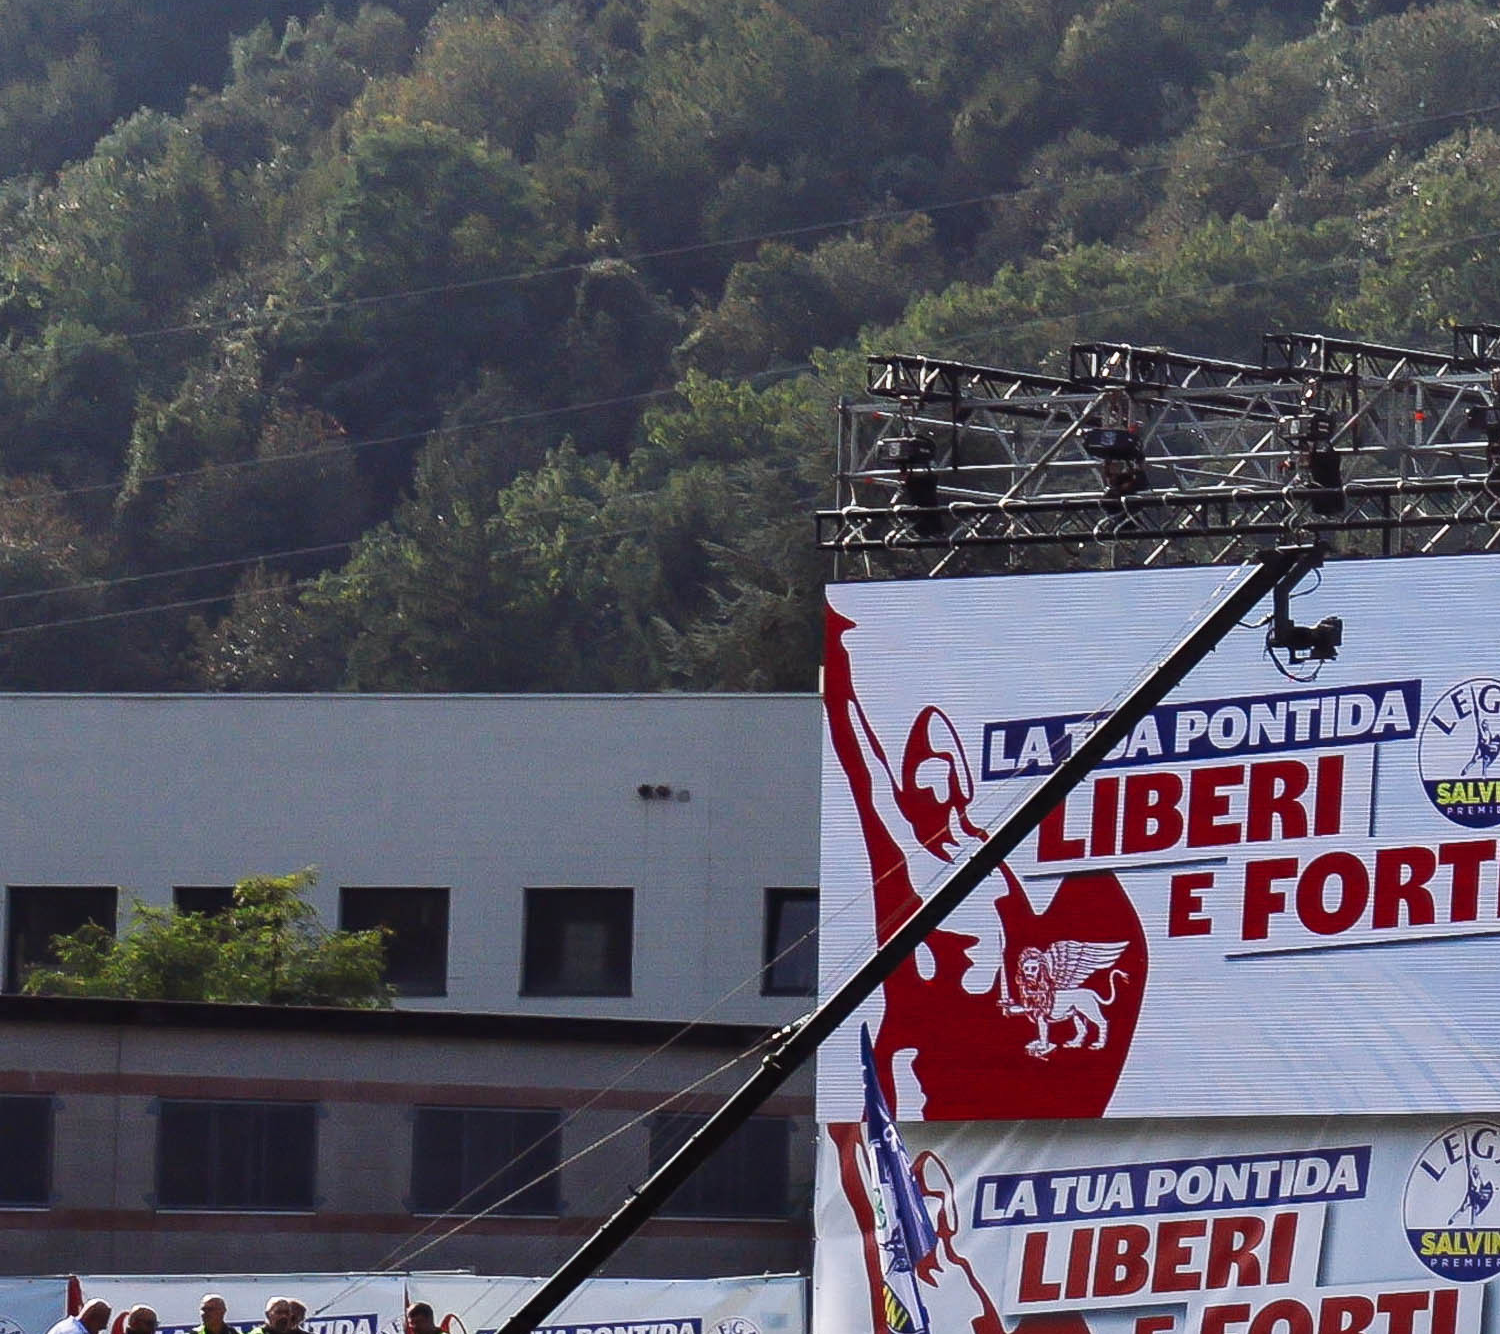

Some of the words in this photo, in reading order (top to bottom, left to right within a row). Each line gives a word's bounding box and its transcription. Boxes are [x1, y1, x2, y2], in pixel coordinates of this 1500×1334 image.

[990, 724, 1052, 771] LA
[1065, 716, 1163, 758] TA
[1174, 689, 1413, 754] PONTIDA
[1037, 755, 1344, 863] LIBERI
[1169, 871, 1214, 938] E
[980, 1178, 1038, 1221] LA
[1051, 1170, 1133, 1215] TUA
[1144, 1152, 1360, 1208] PONTIDA
[1017, 1212, 1299, 1304] LIBERI
